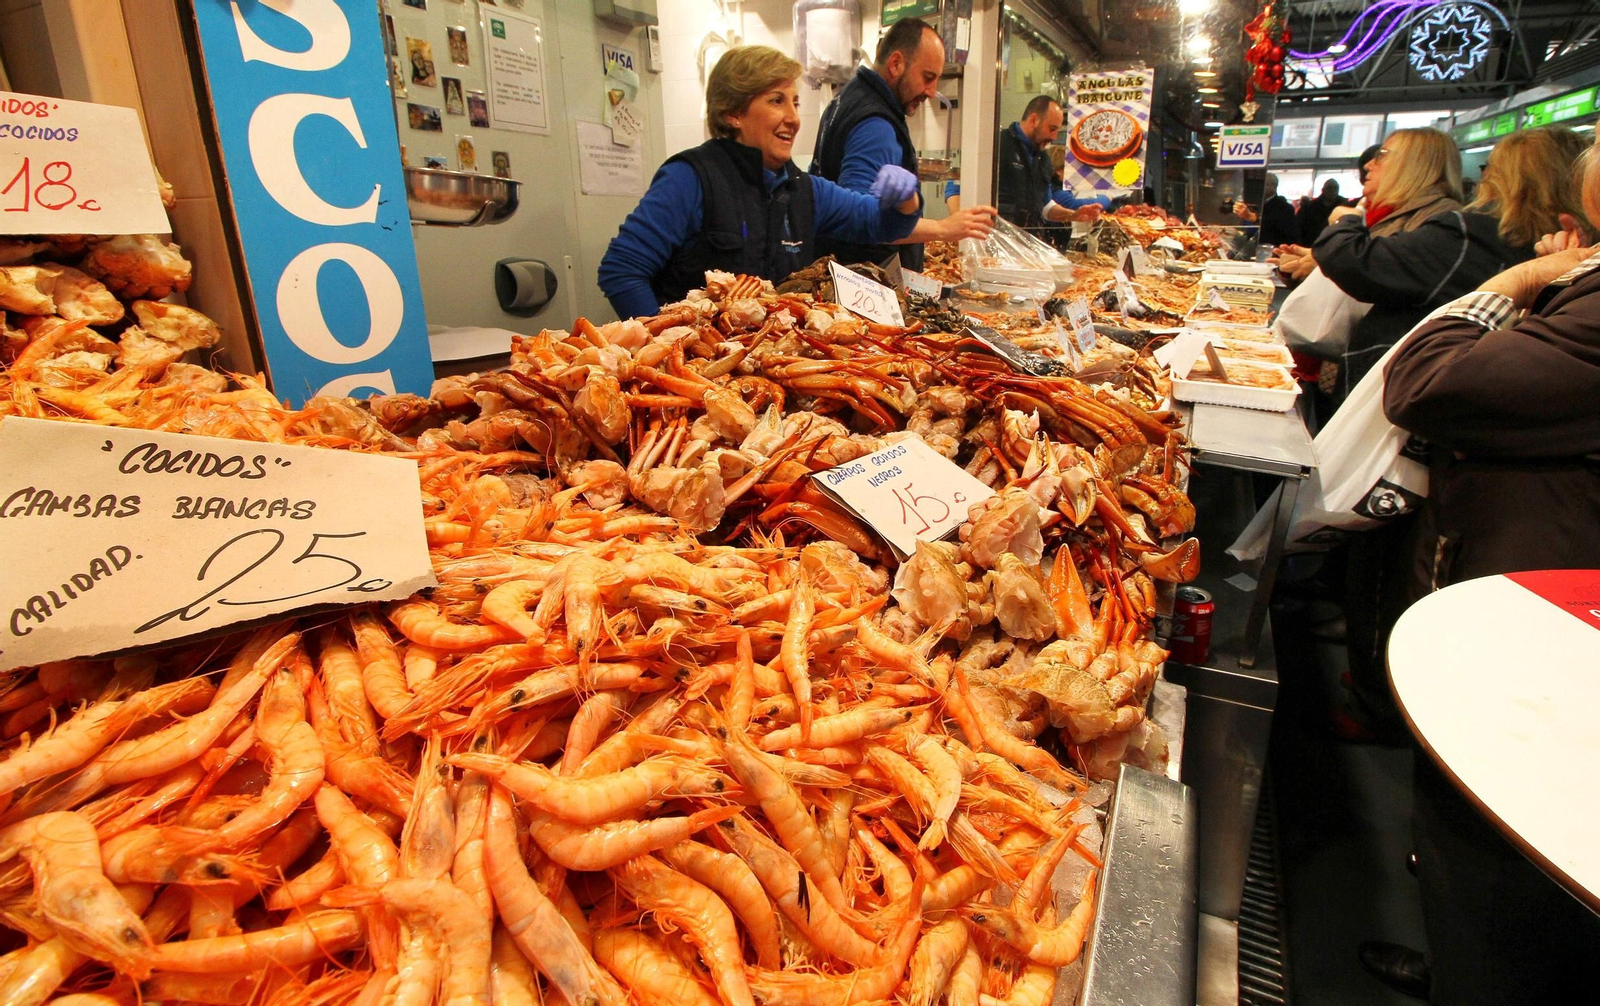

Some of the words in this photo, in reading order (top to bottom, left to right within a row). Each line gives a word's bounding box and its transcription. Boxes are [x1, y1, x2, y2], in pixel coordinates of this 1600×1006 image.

[607, 50, 634, 71] VISA
[1077, 76, 1144, 90] ANGULAS
[1076, 90, 1143, 104] IBAIGUNE
[0, 124, 78, 142] COCIDOS
[1227, 142, 1263, 156] VISA
[229, 0, 406, 400] SCO
[826, 463, 866, 486] CUERPOS
[870, 445, 908, 467] GORDOS
[867, 465, 903, 488] NEGROS
[0, 486, 142, 519] GAMBAS
[172, 496, 317, 520] BLANCAS
